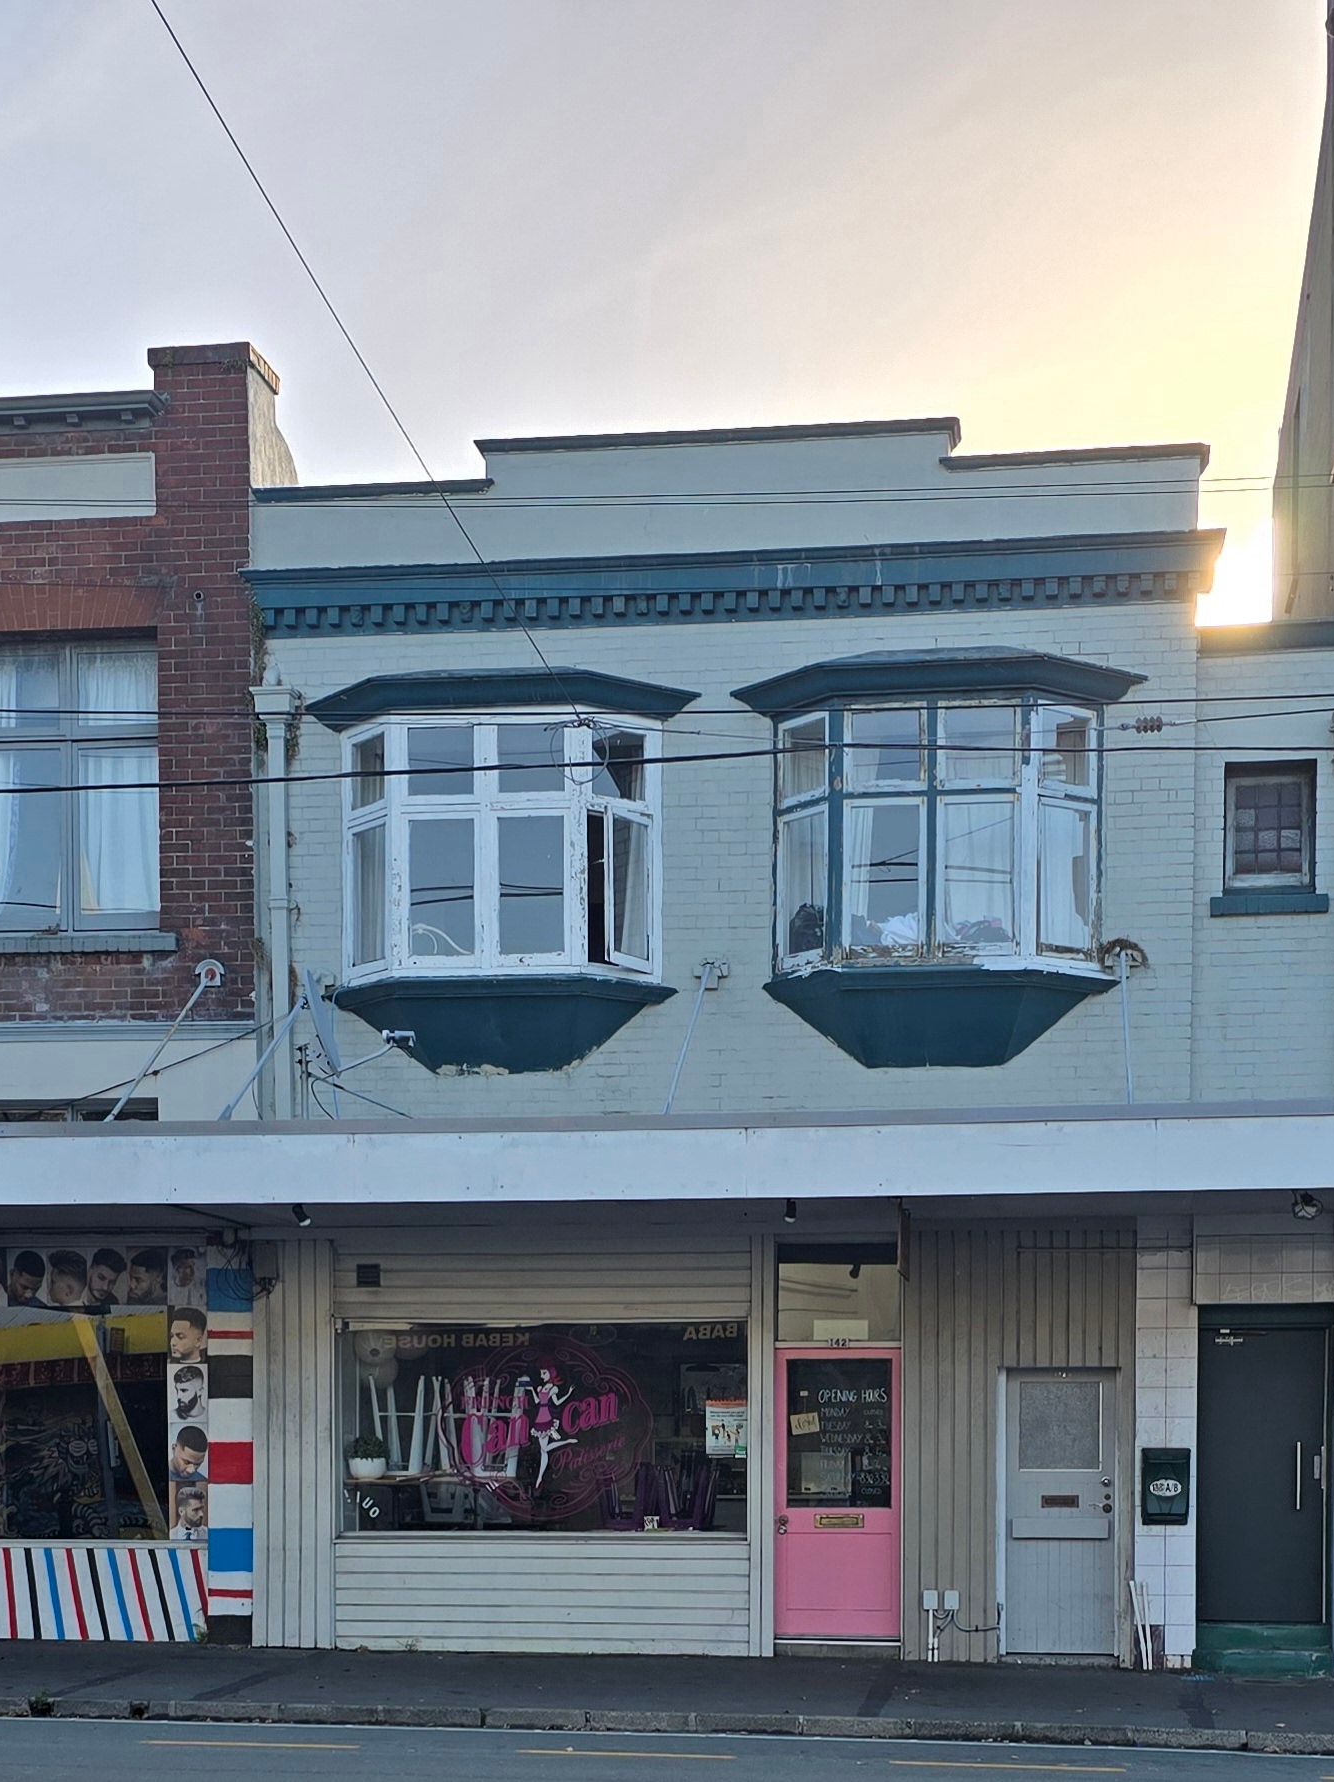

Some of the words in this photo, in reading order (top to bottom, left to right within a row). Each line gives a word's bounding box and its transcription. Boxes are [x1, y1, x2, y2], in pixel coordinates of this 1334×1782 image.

[829, 1339, 847, 1347] 142
[818, 1389, 858, 1404] OPENING
[861, 1387, 888, 1404] HOURS
[460, 1412, 532, 1468] Can
